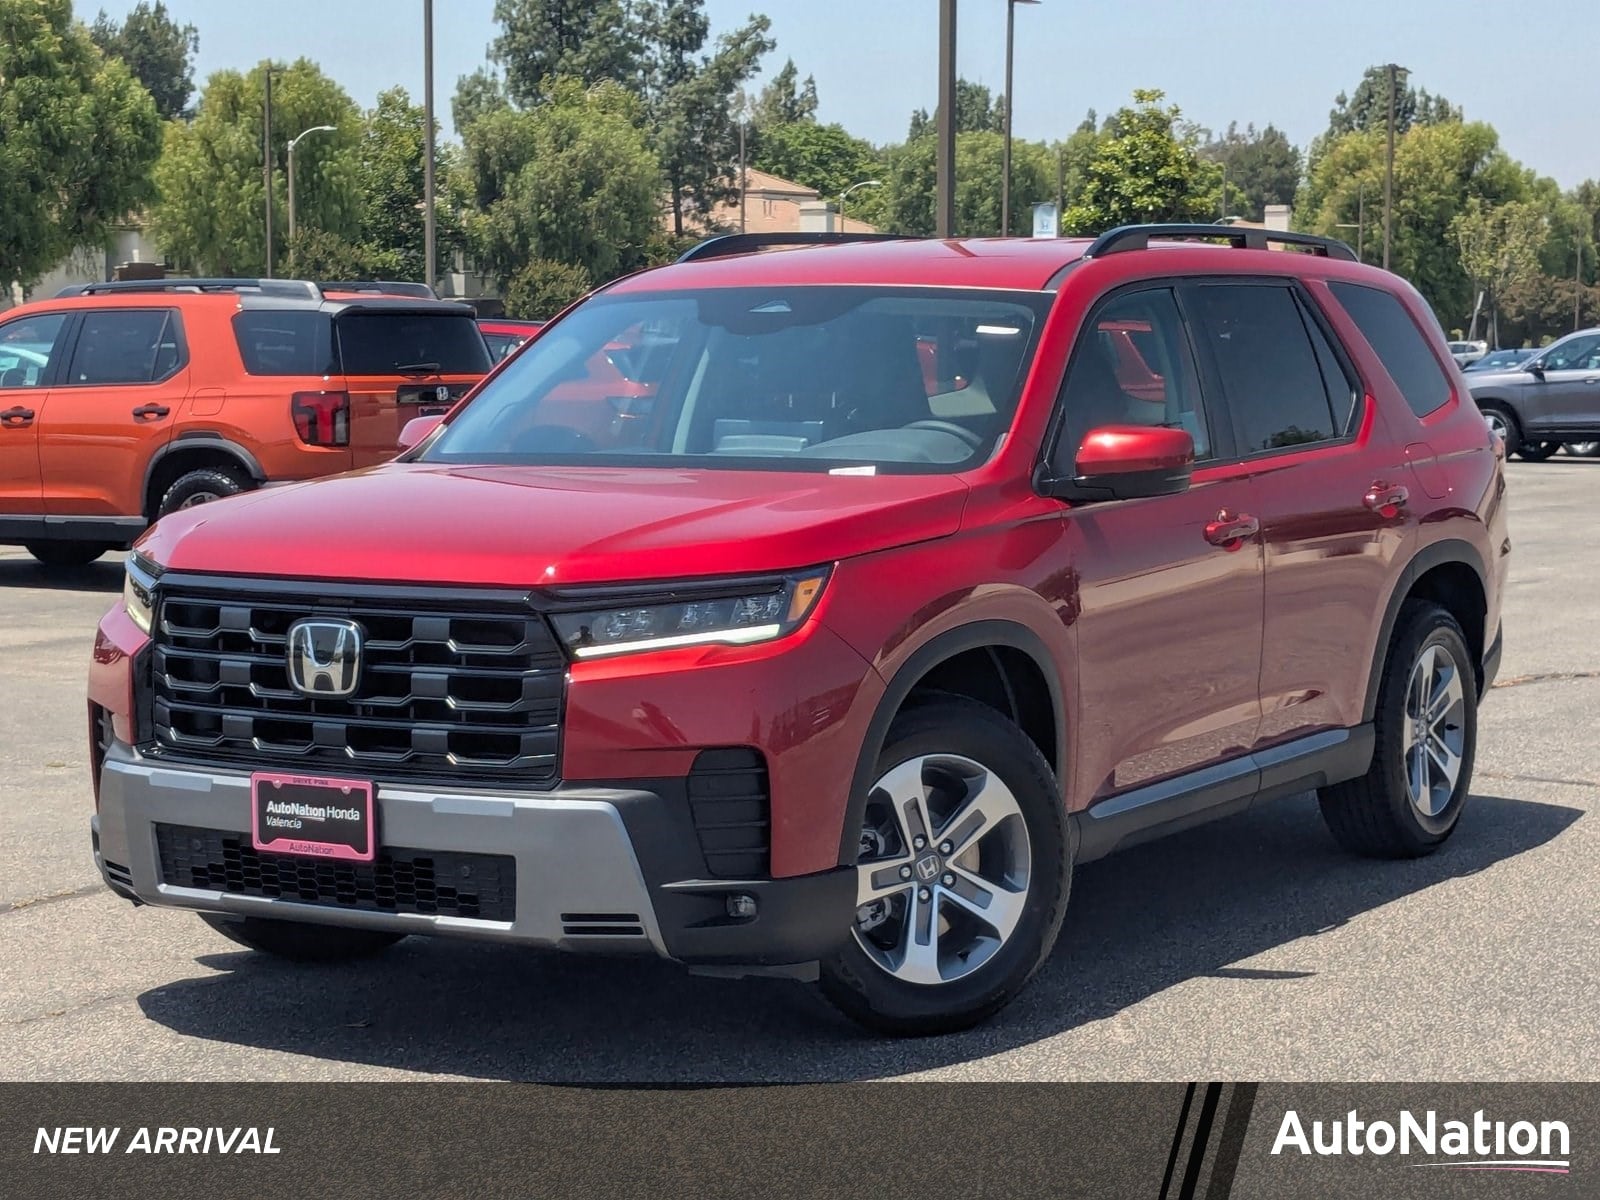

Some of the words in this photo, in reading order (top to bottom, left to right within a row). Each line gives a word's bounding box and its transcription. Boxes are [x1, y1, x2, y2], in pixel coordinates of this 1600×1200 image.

[266, 800, 326, 817] AutoNation
[326, 805, 360, 820] Honda
[266, 815, 302, 829] Valencia
[289, 842, 334, 855] AutoNation
